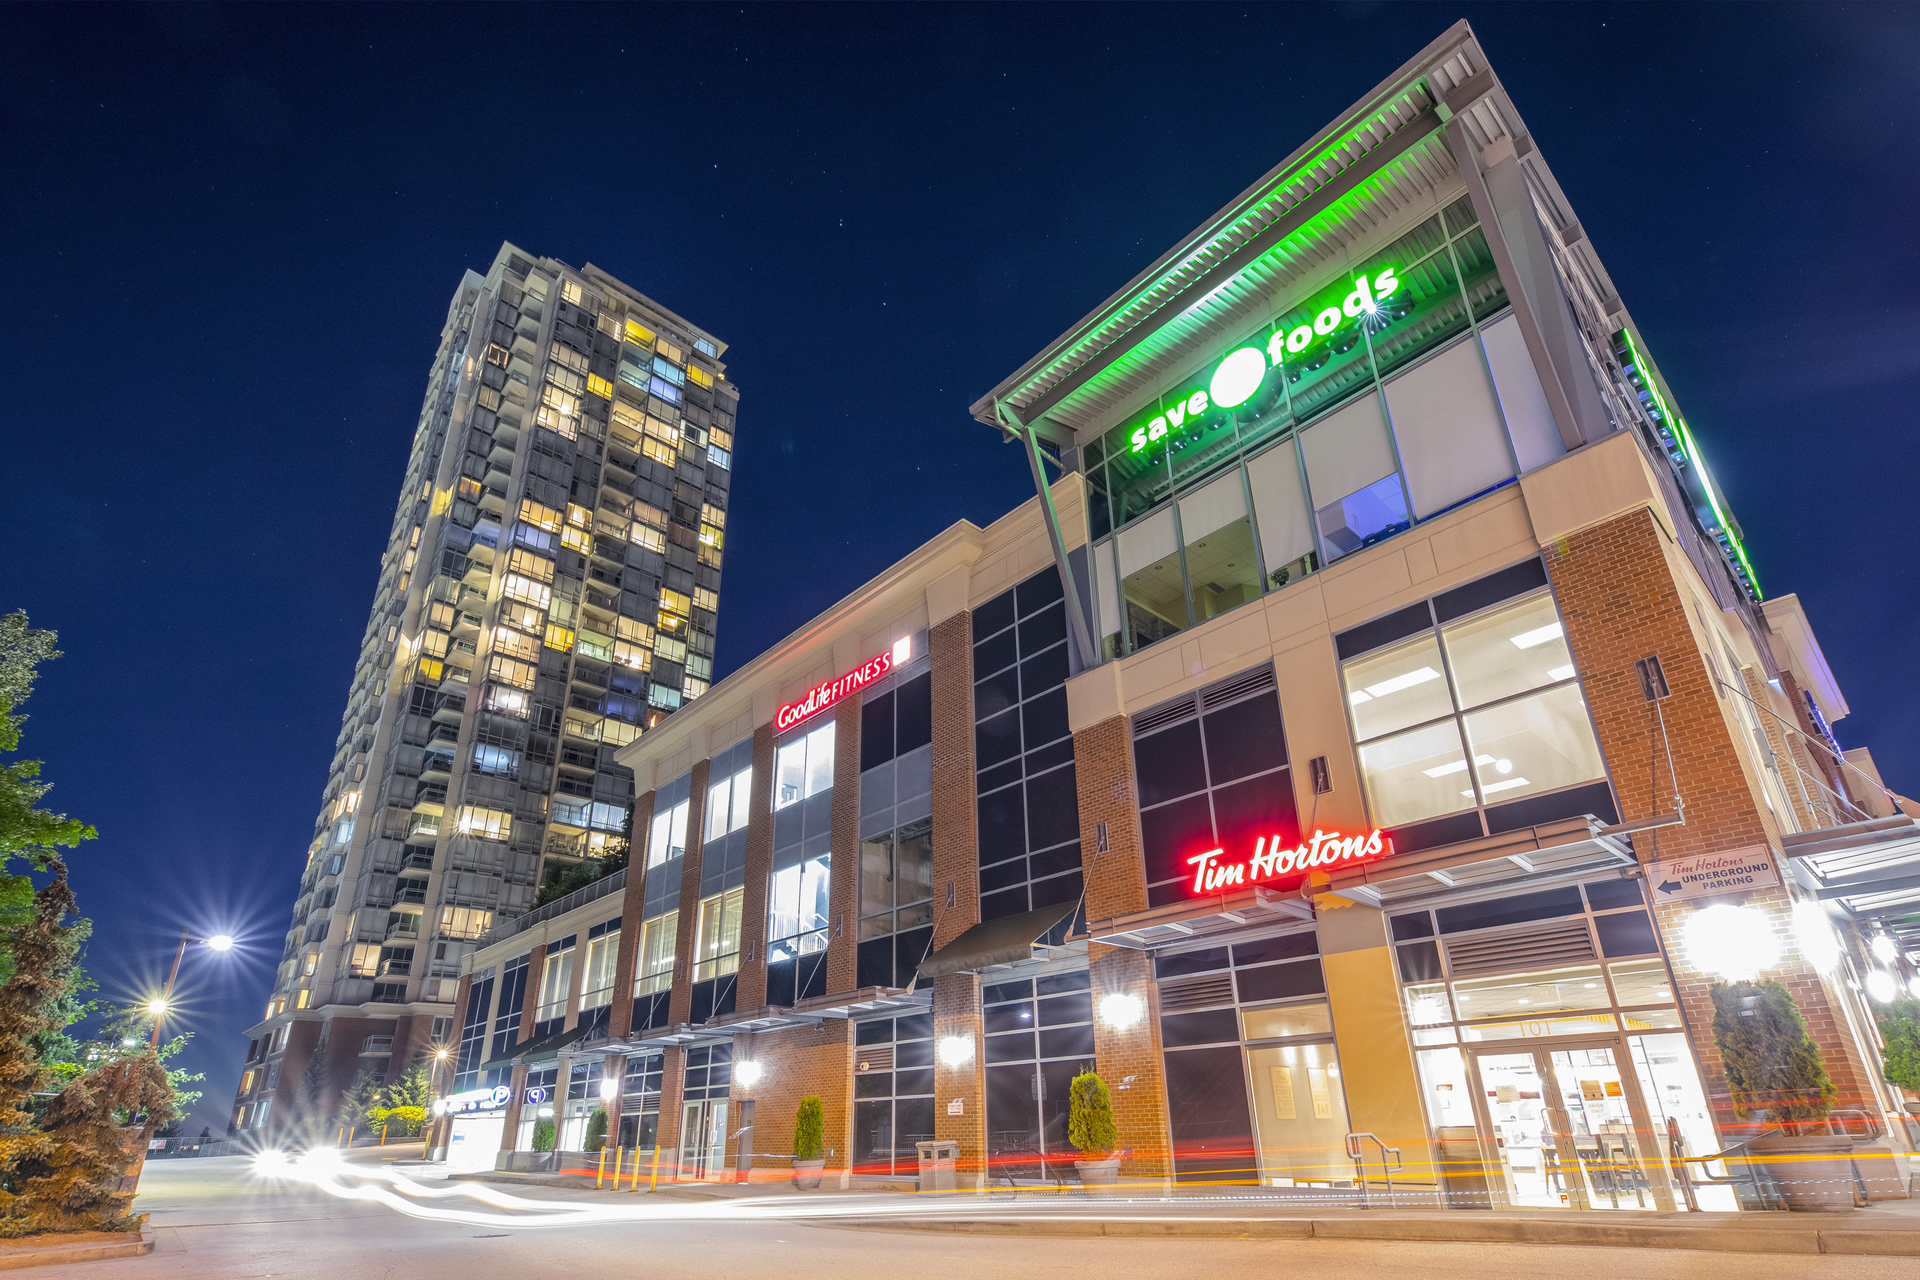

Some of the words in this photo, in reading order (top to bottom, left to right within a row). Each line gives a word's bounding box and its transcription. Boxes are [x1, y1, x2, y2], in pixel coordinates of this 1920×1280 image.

[1131, 390, 1209, 453] save
[1266, 267, 1399, 367] foods
[831, 651, 890, 700] FITNESS
[1187, 848, 1244, 893] Tim
[1249, 829, 1383, 880] Hortons
[1669, 861, 1693, 876] Tim
[1695, 857, 1744, 872] Hortons
[1681, 862, 1769, 884] UNDERGROUND
[1702, 875, 1754, 890] PARKING
[1520, 1020, 1551, 1037] 101
